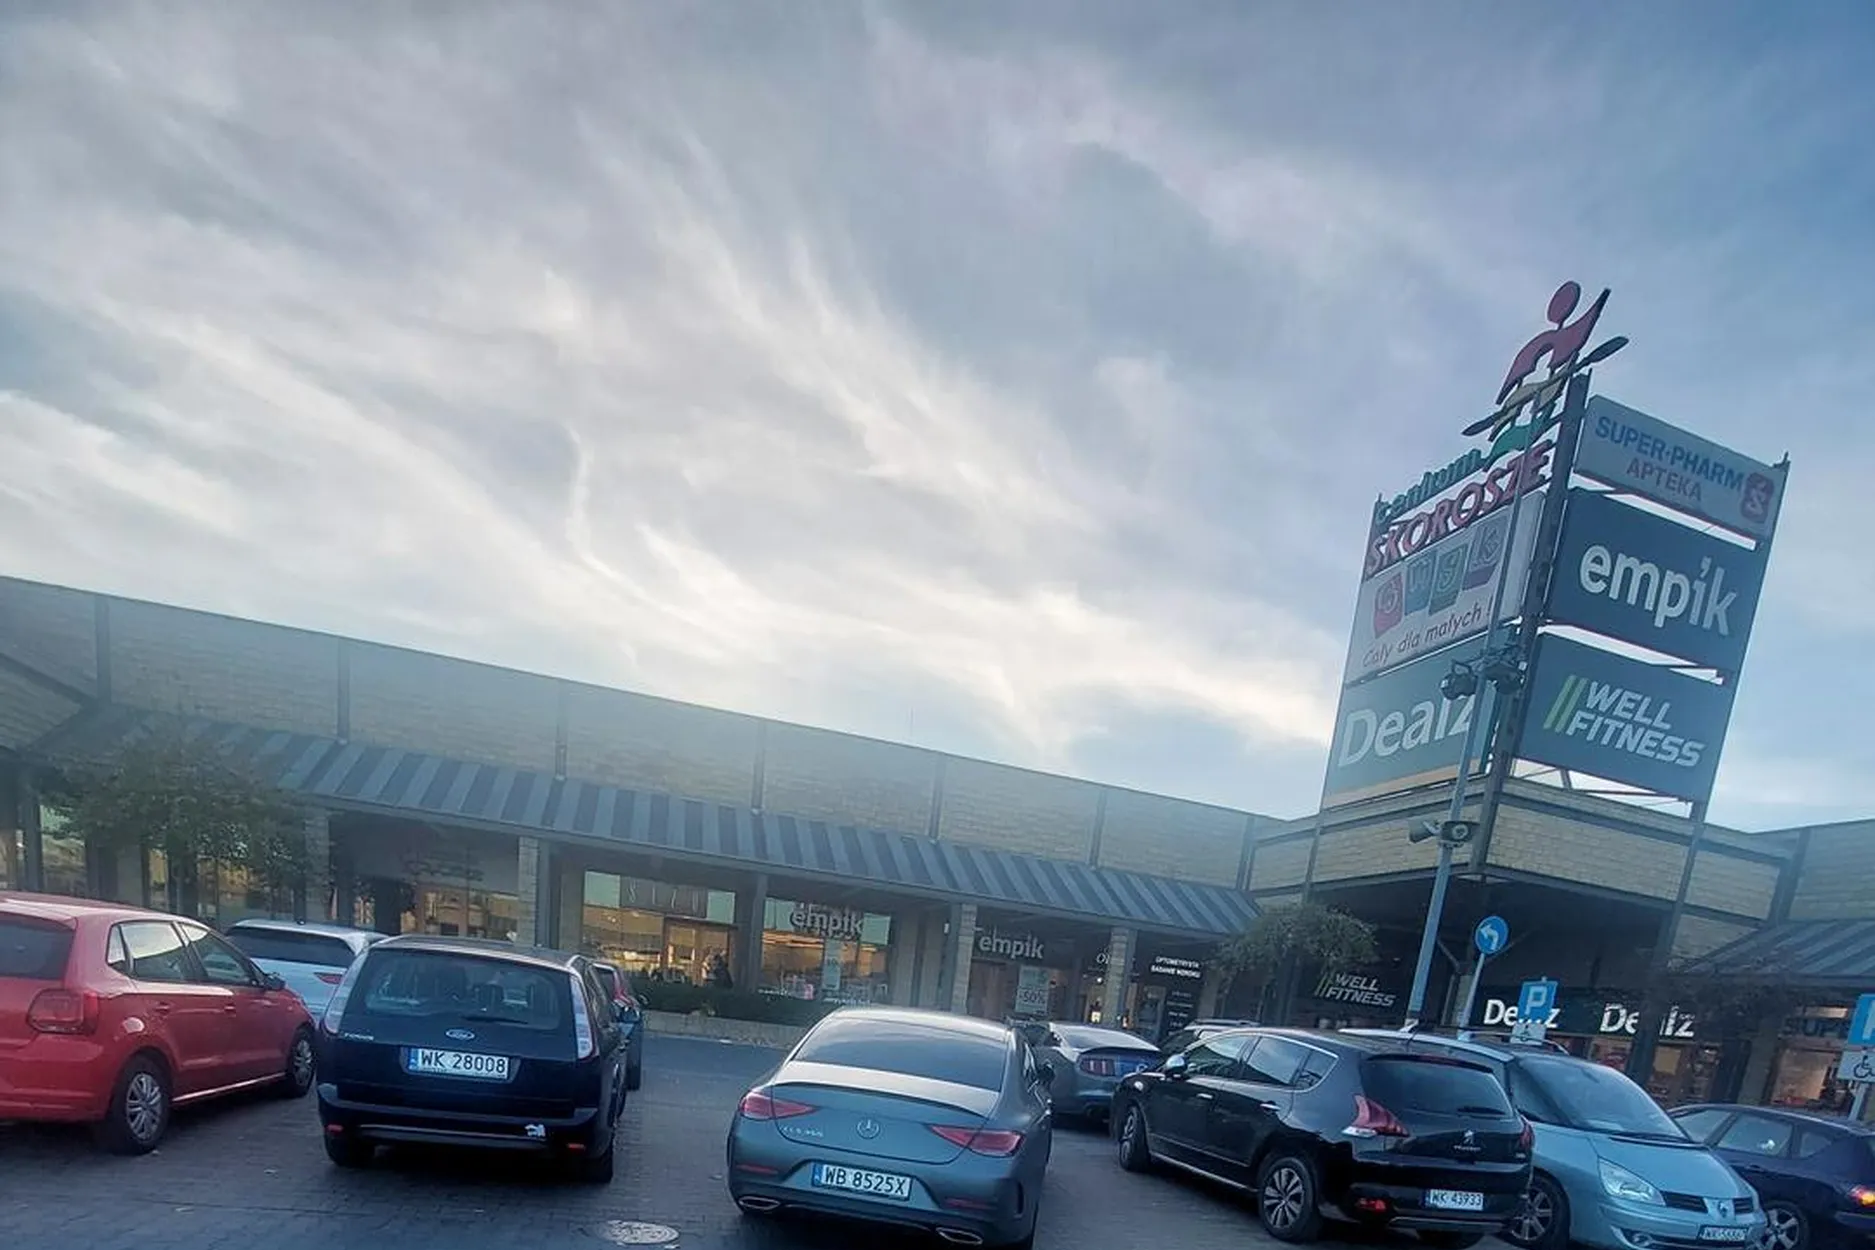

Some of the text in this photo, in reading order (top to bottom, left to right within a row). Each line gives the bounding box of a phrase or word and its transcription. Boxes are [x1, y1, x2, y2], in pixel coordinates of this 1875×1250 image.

[1595, 416, 1746, 492] SUPER-PHARM
[1626, 457, 1703, 500] APTEKA
[1364, 439, 1553, 577] SKOROSZE
[1579, 544, 1737, 637] empik
[1586, 680, 1672, 731] WELL
[1565, 710, 1708, 768] FITNESS
[790, 908, 862, 938] empik
[979, 930, 1045, 960] empik
[1325, 986, 1397, 1007] FITNESS
[1336, 973, 1379, 992] WELL
[1483, 999, 1561, 1029] Dez
[1525, 985, 1548, 1015] P
[1600, 1002, 1696, 1038] Delz
[421, 1050, 506, 1074] WK 28008
[825, 1166, 906, 1195] WB 8525X
